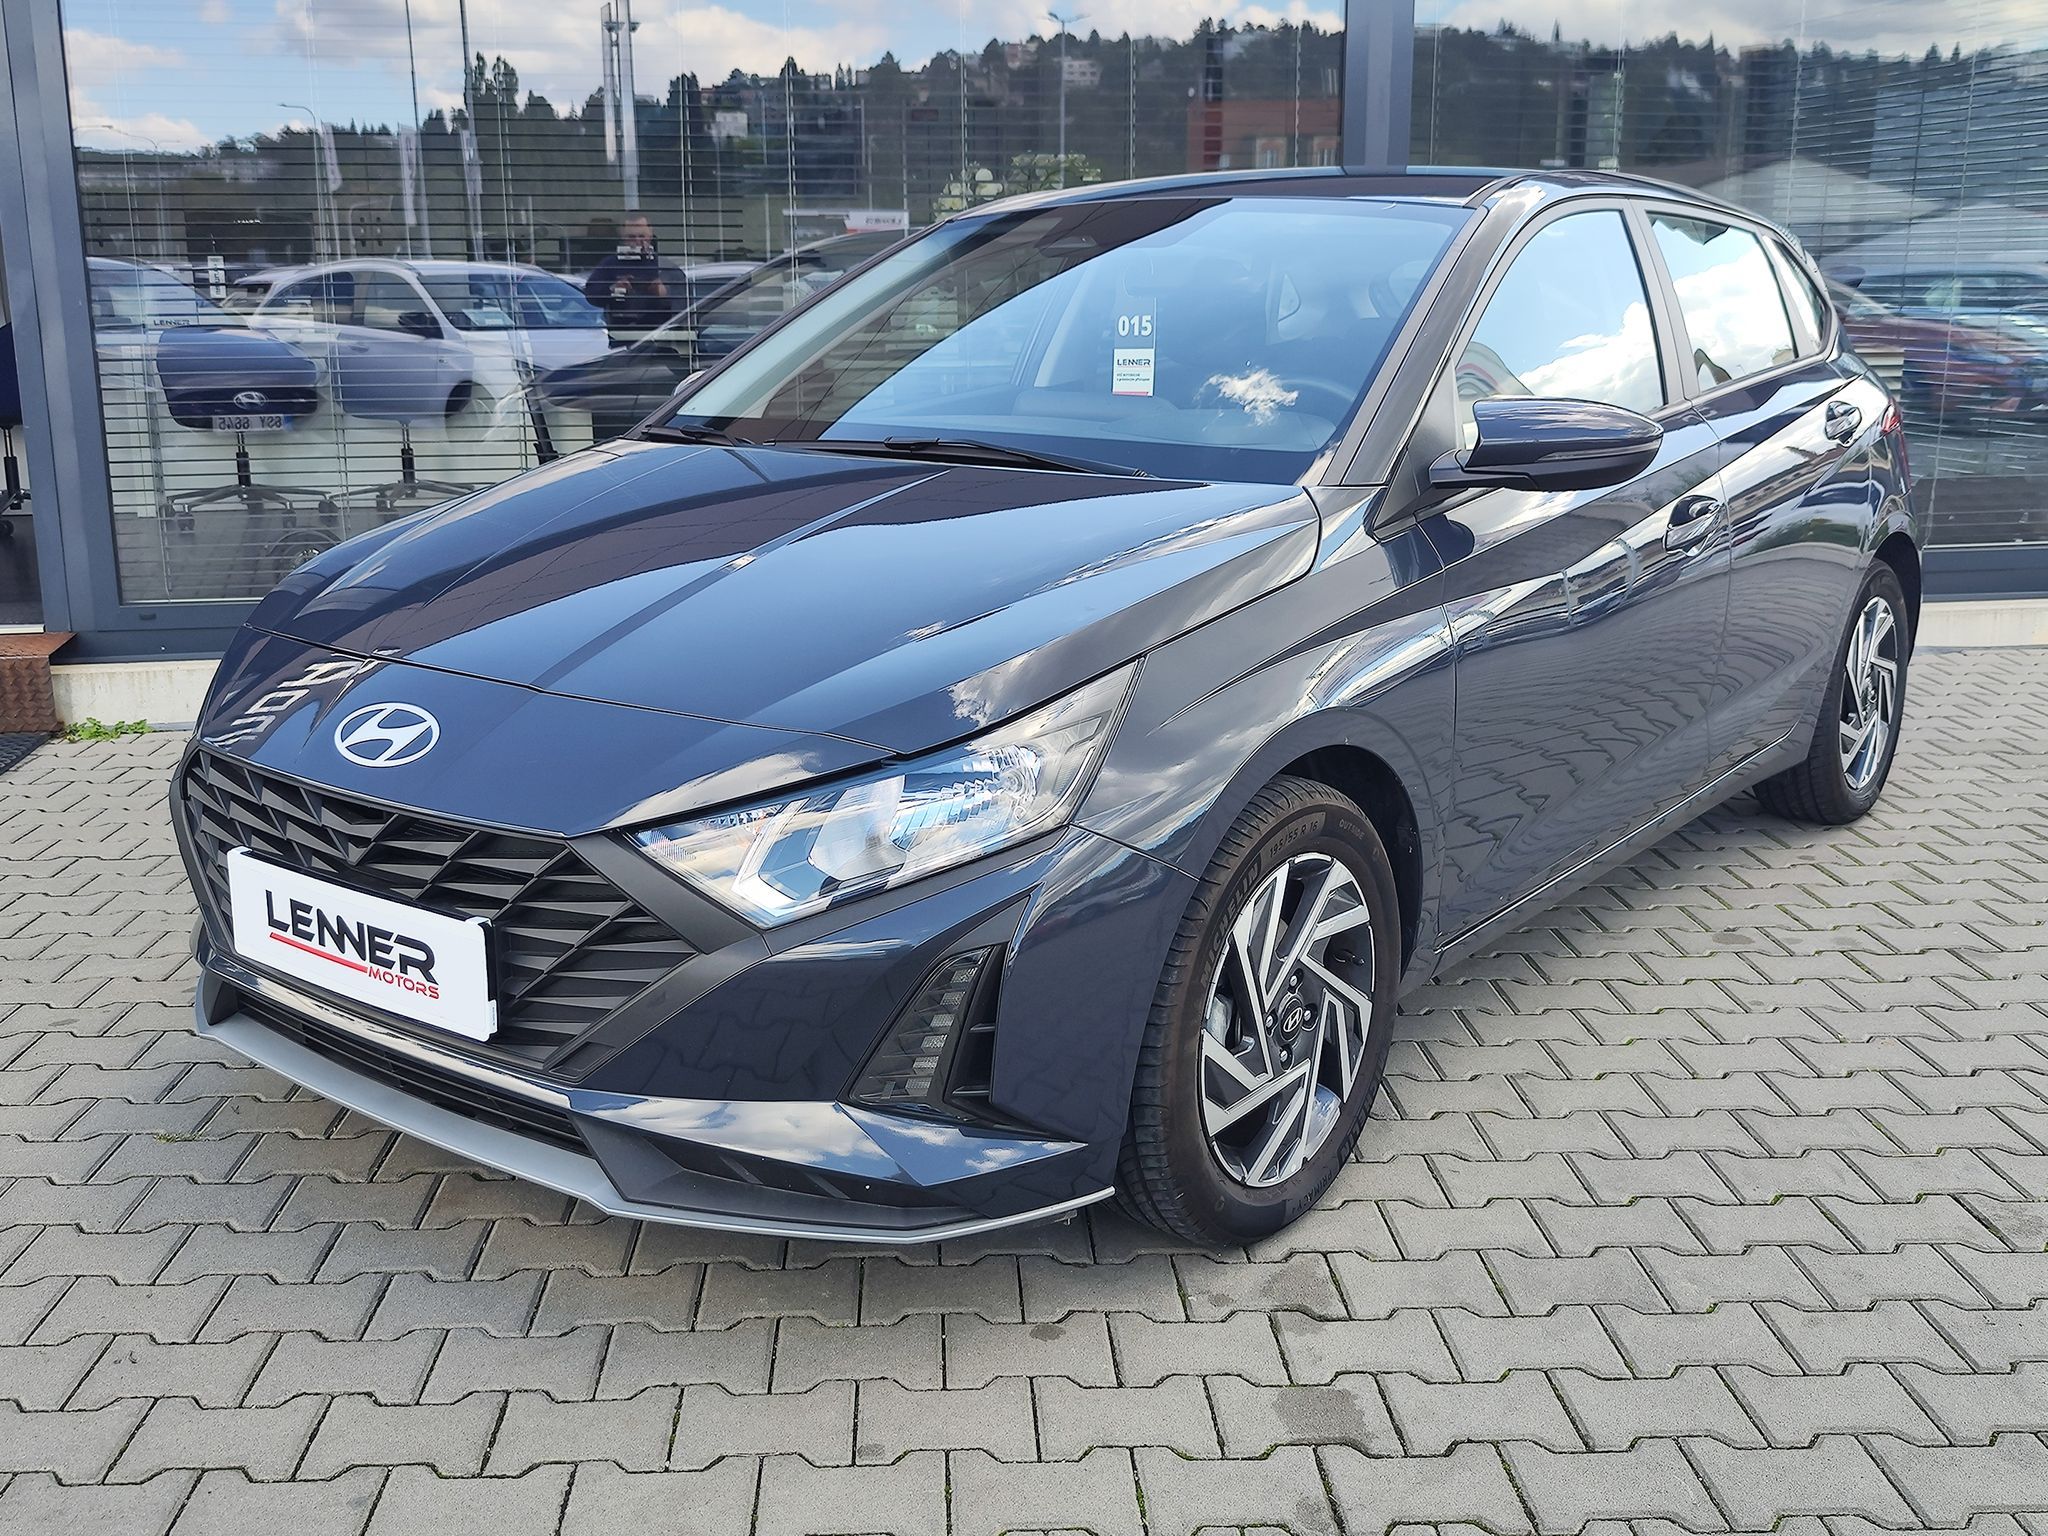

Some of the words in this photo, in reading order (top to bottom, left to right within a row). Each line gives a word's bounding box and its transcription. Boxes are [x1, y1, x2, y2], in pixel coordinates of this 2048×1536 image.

[1117, 315, 1152, 337] 015
[1116, 358, 1151, 366] LENNER
[265, 889, 439, 986] LENNER
[1200, 862, 1260, 988] MICHELIN
[368, 966, 440, 1000] MOTORS
